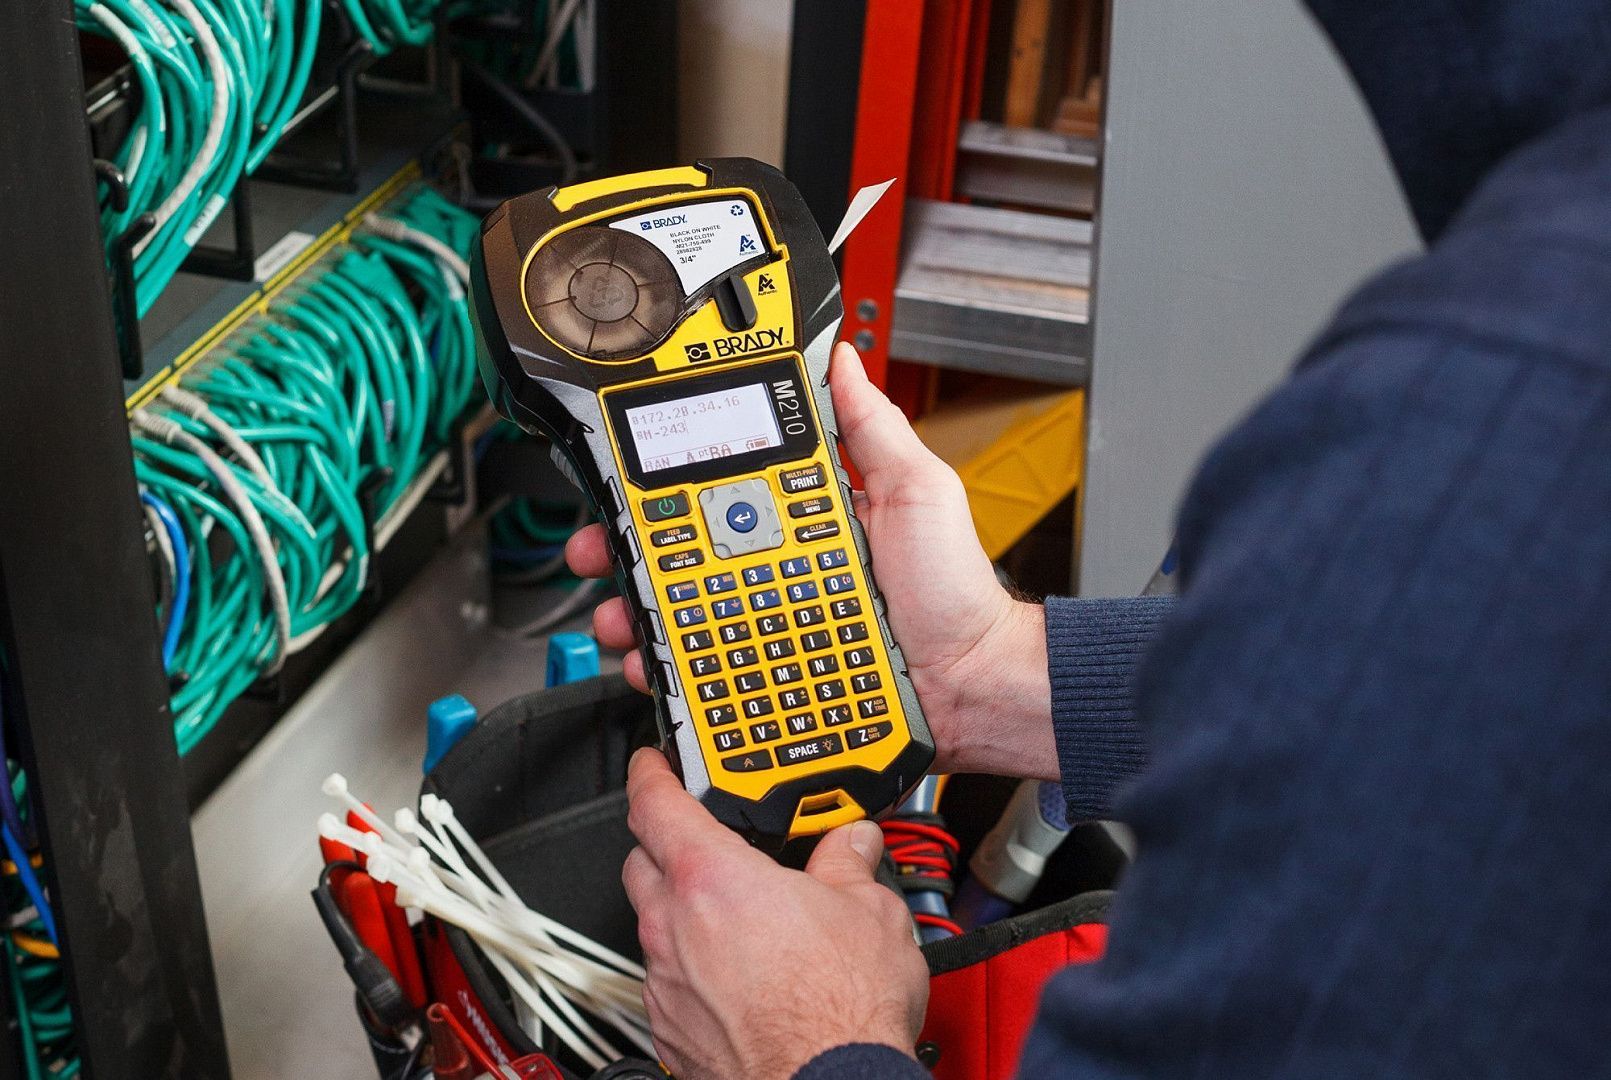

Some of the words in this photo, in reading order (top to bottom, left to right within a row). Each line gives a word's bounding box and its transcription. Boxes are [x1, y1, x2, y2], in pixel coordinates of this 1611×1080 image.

[653, 214, 687, 229] BRADY
[669, 229, 691, 238] BLACK
[691, 227, 701, 235] ON
[701, 225, 721, 233] WHITE
[672, 236, 694, 244] NYLON
[694, 232, 715, 240] CLOTH
[679, 255, 697, 264] 3/4"
[713, 327, 784, 357] BRADY
[772, 379, 806, 435] M210
[786, 467, 818, 479] MULTI-PRINT
[790, 475, 818, 489] PRINT
[805, 505, 821, 513] MENU
[666, 528, 680, 536] FEED
[809, 523, 827, 532] CLEAR
[660, 535, 677, 544] LABEL
[679, 533, 692, 541] TYPE
[674, 552, 689, 560] CAPS
[823, 554, 832, 567] 5
[670, 560, 684, 569] FONT
[685, 557, 697, 565] SIZE
[787, 562, 796, 574] 4
[749, 570, 758, 582] 3
[711, 578, 720, 591] 2
[830, 578, 840, 591] 0
[673, 586, 681, 599] 1
[793, 586, 803, 599] 9
[756, 595, 765, 607] 8
[718, 603, 726, 615] 7
[837, 603, 847, 616] E
[681, 611, 690, 624] 6
[800, 610, 811, 624] D
[763, 619, 774, 632] C
[725, 627, 736, 641] B
[845, 627, 853, 640] J
[689, 636, 699, 649] A
[808, 636, 815, 648] I
[770, 643, 782, 656] H
[733, 652, 744, 665] G
[851, 652, 861, 665] O
[696, 660, 705, 673] F
[814, 660, 826, 673] N
[777, 668, 791, 682] M
[741, 677, 751, 690] L
[857, 677, 866, 689] T
[704, 685, 715, 698] K
[822, 685, 832, 698] S
[785, 693, 797, 706] R
[749, 701, 760, 715] Q
[863, 701, 873, 714] Y
[712, 710, 721, 723] P
[828, 709, 840, 723] X
[792, 717, 806, 731] W
[756, 726, 766, 740] V
[859, 730, 869, 743] Z
[720, 734, 731, 748] U
[788, 743, 820, 759] SPACE
